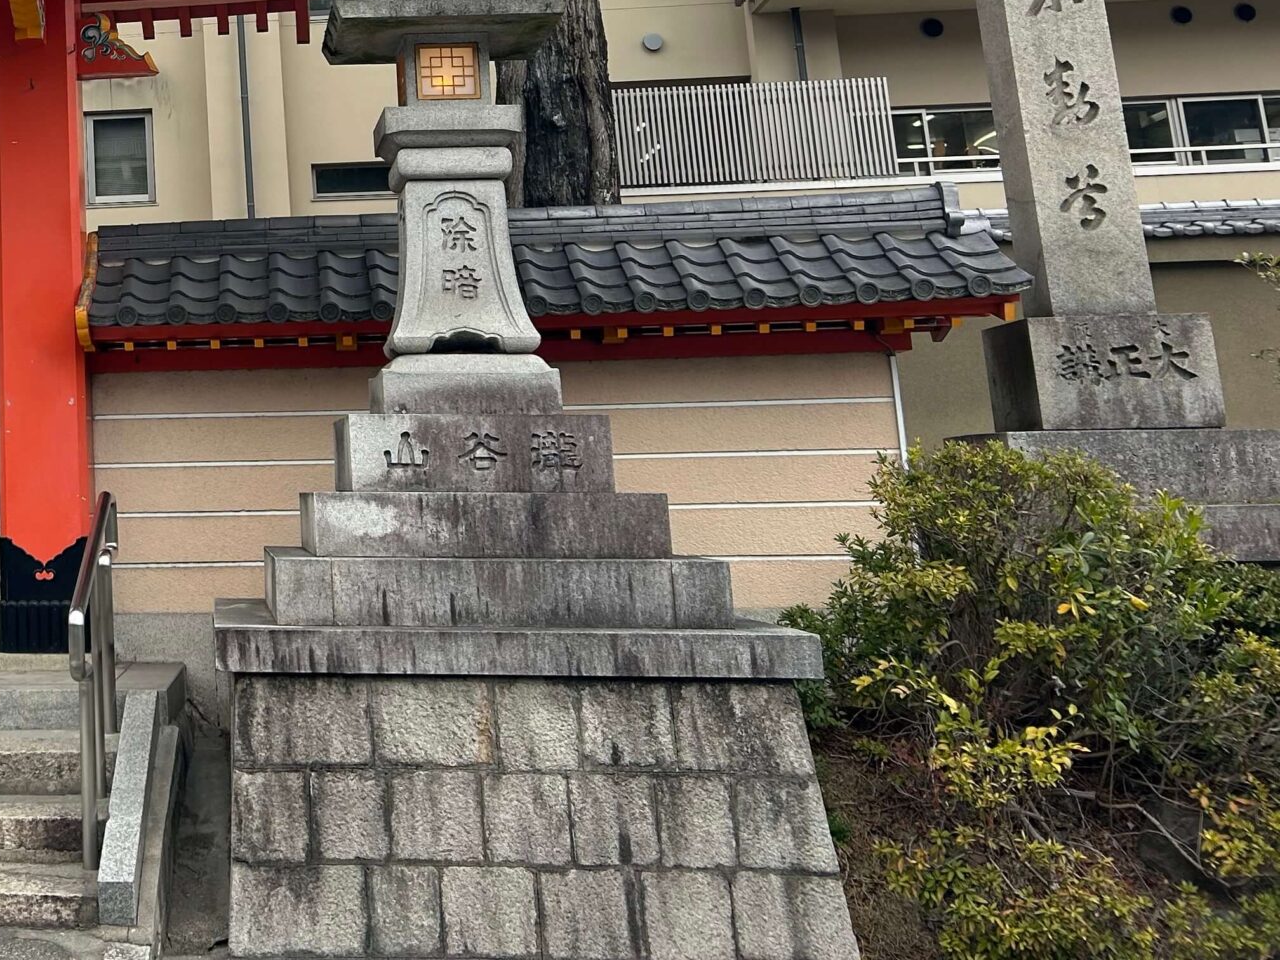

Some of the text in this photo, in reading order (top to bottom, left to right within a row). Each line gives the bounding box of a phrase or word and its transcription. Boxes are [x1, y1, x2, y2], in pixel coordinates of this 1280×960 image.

[440, 216, 482, 300] 除暗
[384, 431, 584, 475] 瀧谷山
